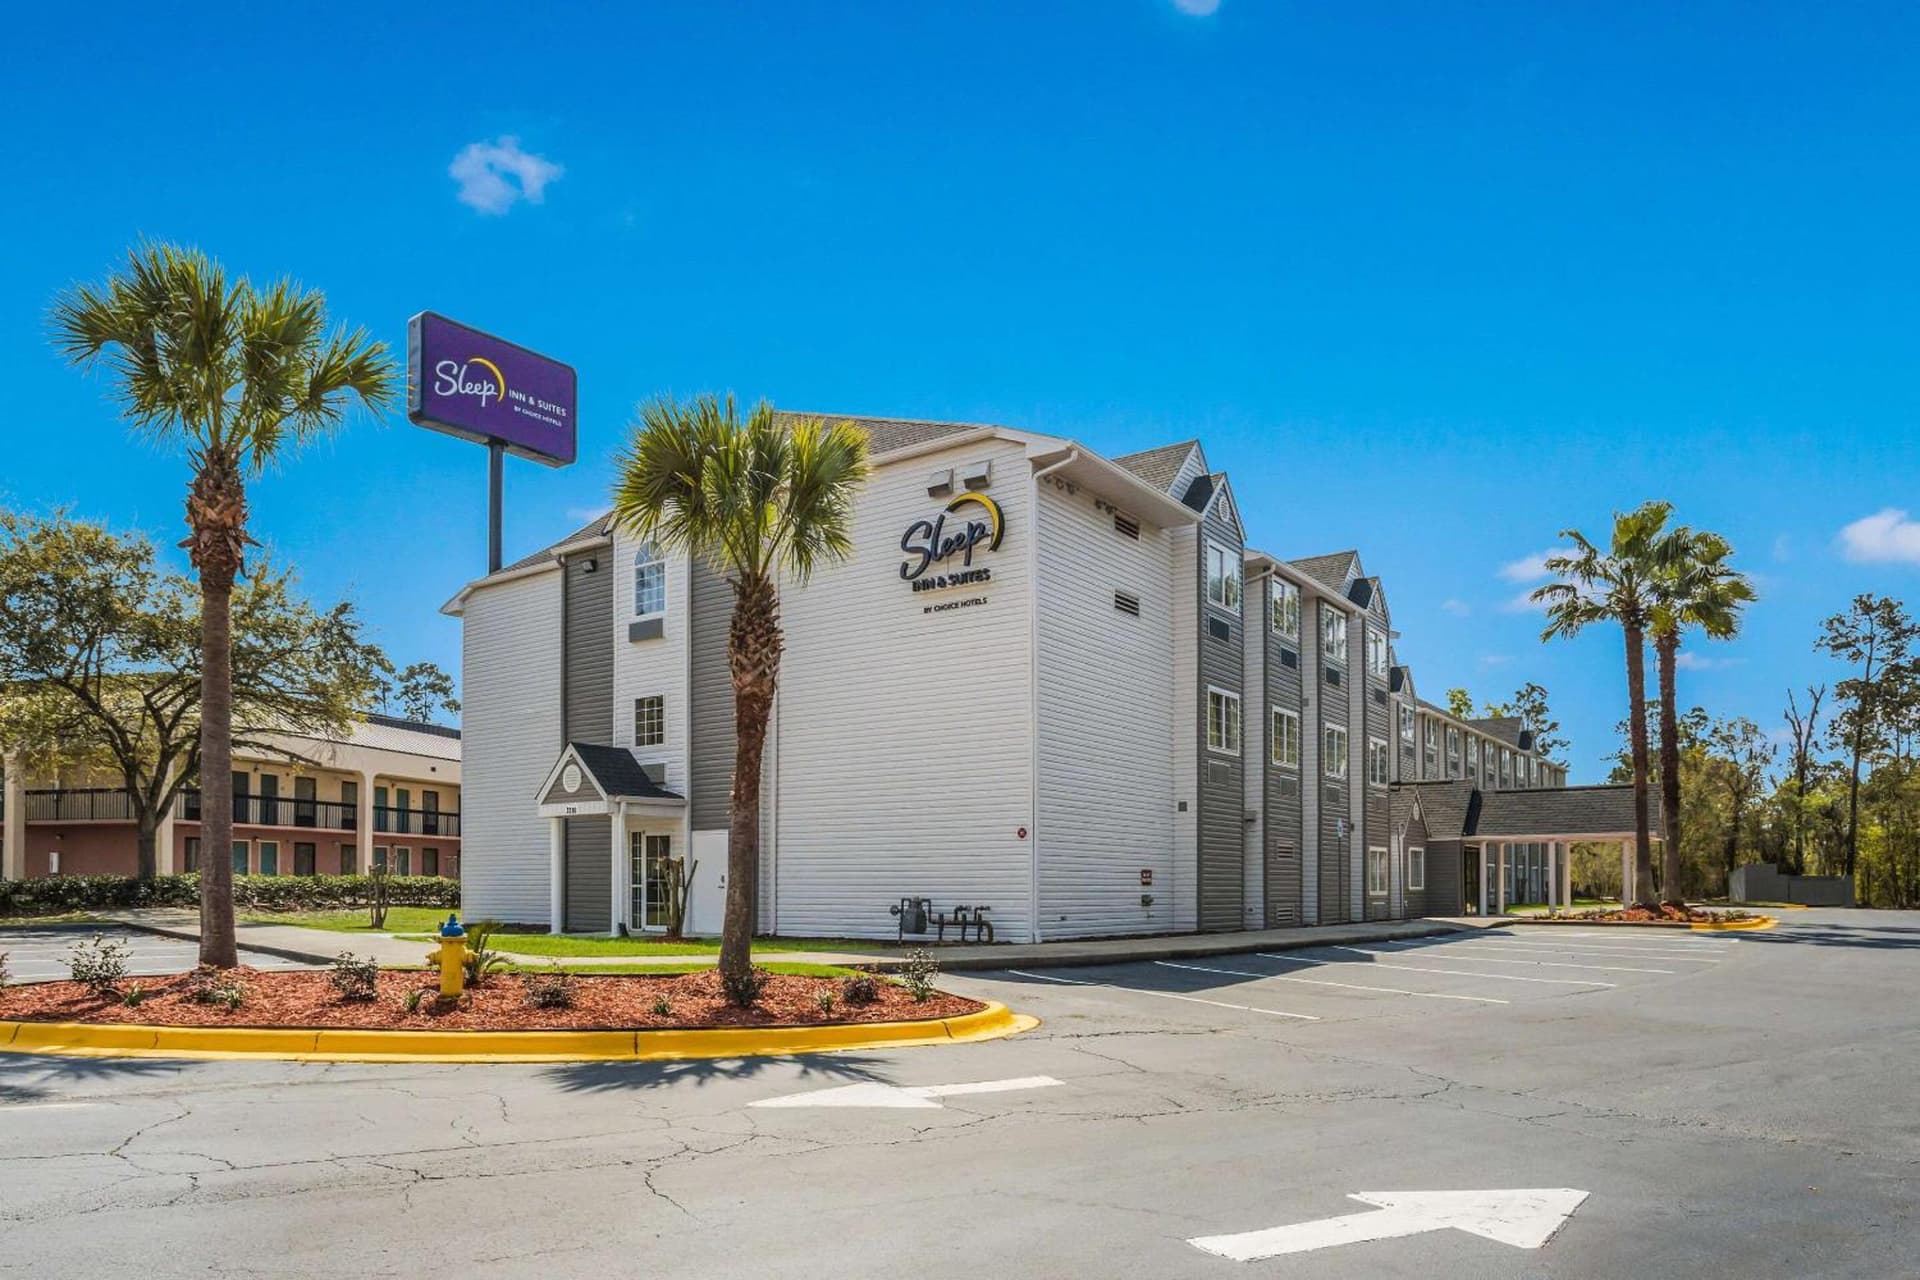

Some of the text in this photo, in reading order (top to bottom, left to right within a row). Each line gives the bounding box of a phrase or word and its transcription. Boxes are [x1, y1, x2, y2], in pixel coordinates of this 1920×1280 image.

[434, 360, 498, 407] Sleep
[508, 388, 567, 417] INN & SUITES
[900, 513, 993, 580] Sleep
[912, 568, 991, 592] INN & SUITES
[934, 602, 959, 612] CHOICE
[960, 597, 988, 608] HOTELS
